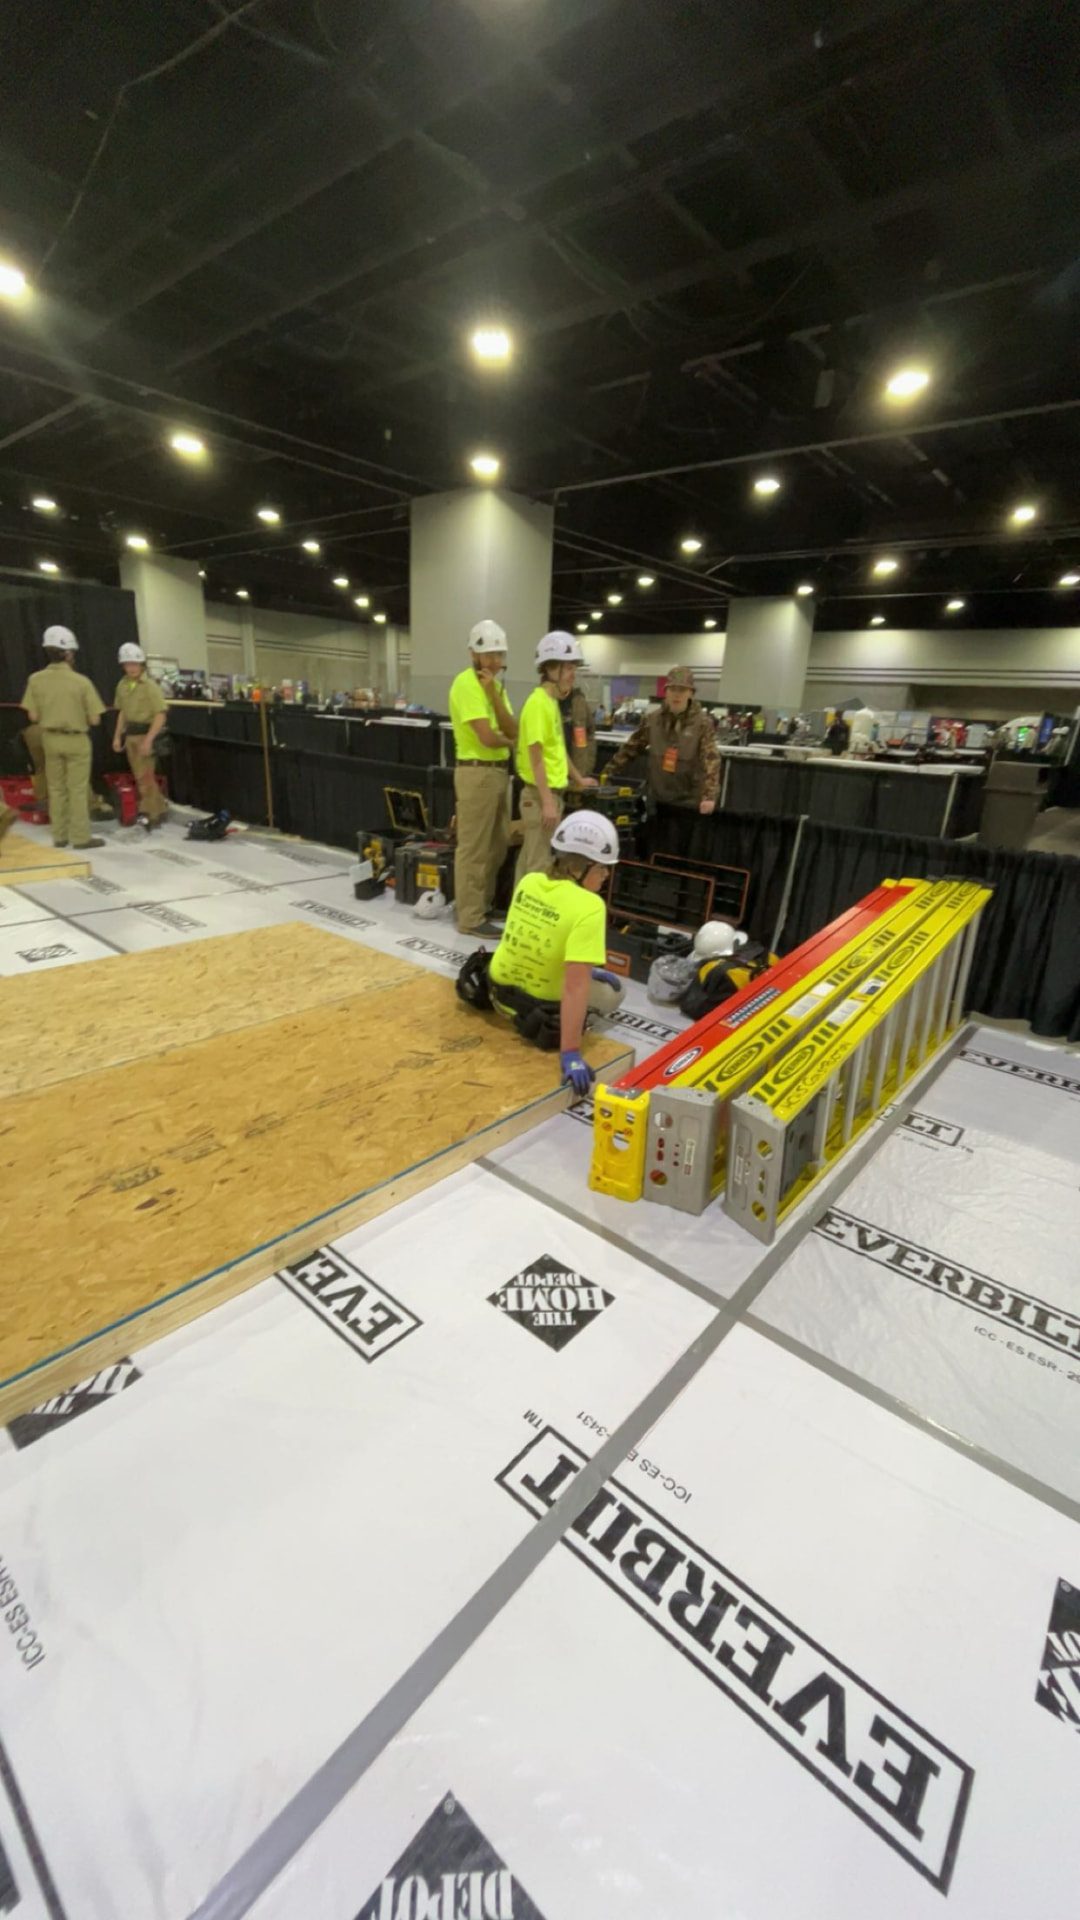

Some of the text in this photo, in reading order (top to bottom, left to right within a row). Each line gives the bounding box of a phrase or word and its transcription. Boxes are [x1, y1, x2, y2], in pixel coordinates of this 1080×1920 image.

[514, 1273, 582, 1287] DEPOT
[496, 1286, 607, 1312] HOME
[533, 1311, 577, 1326] THE
[522, 1409, 543, 1430] TM
[639, 1458, 693, 1504] ICC-ES
[371, 1870, 515, 1920] DEPOT
